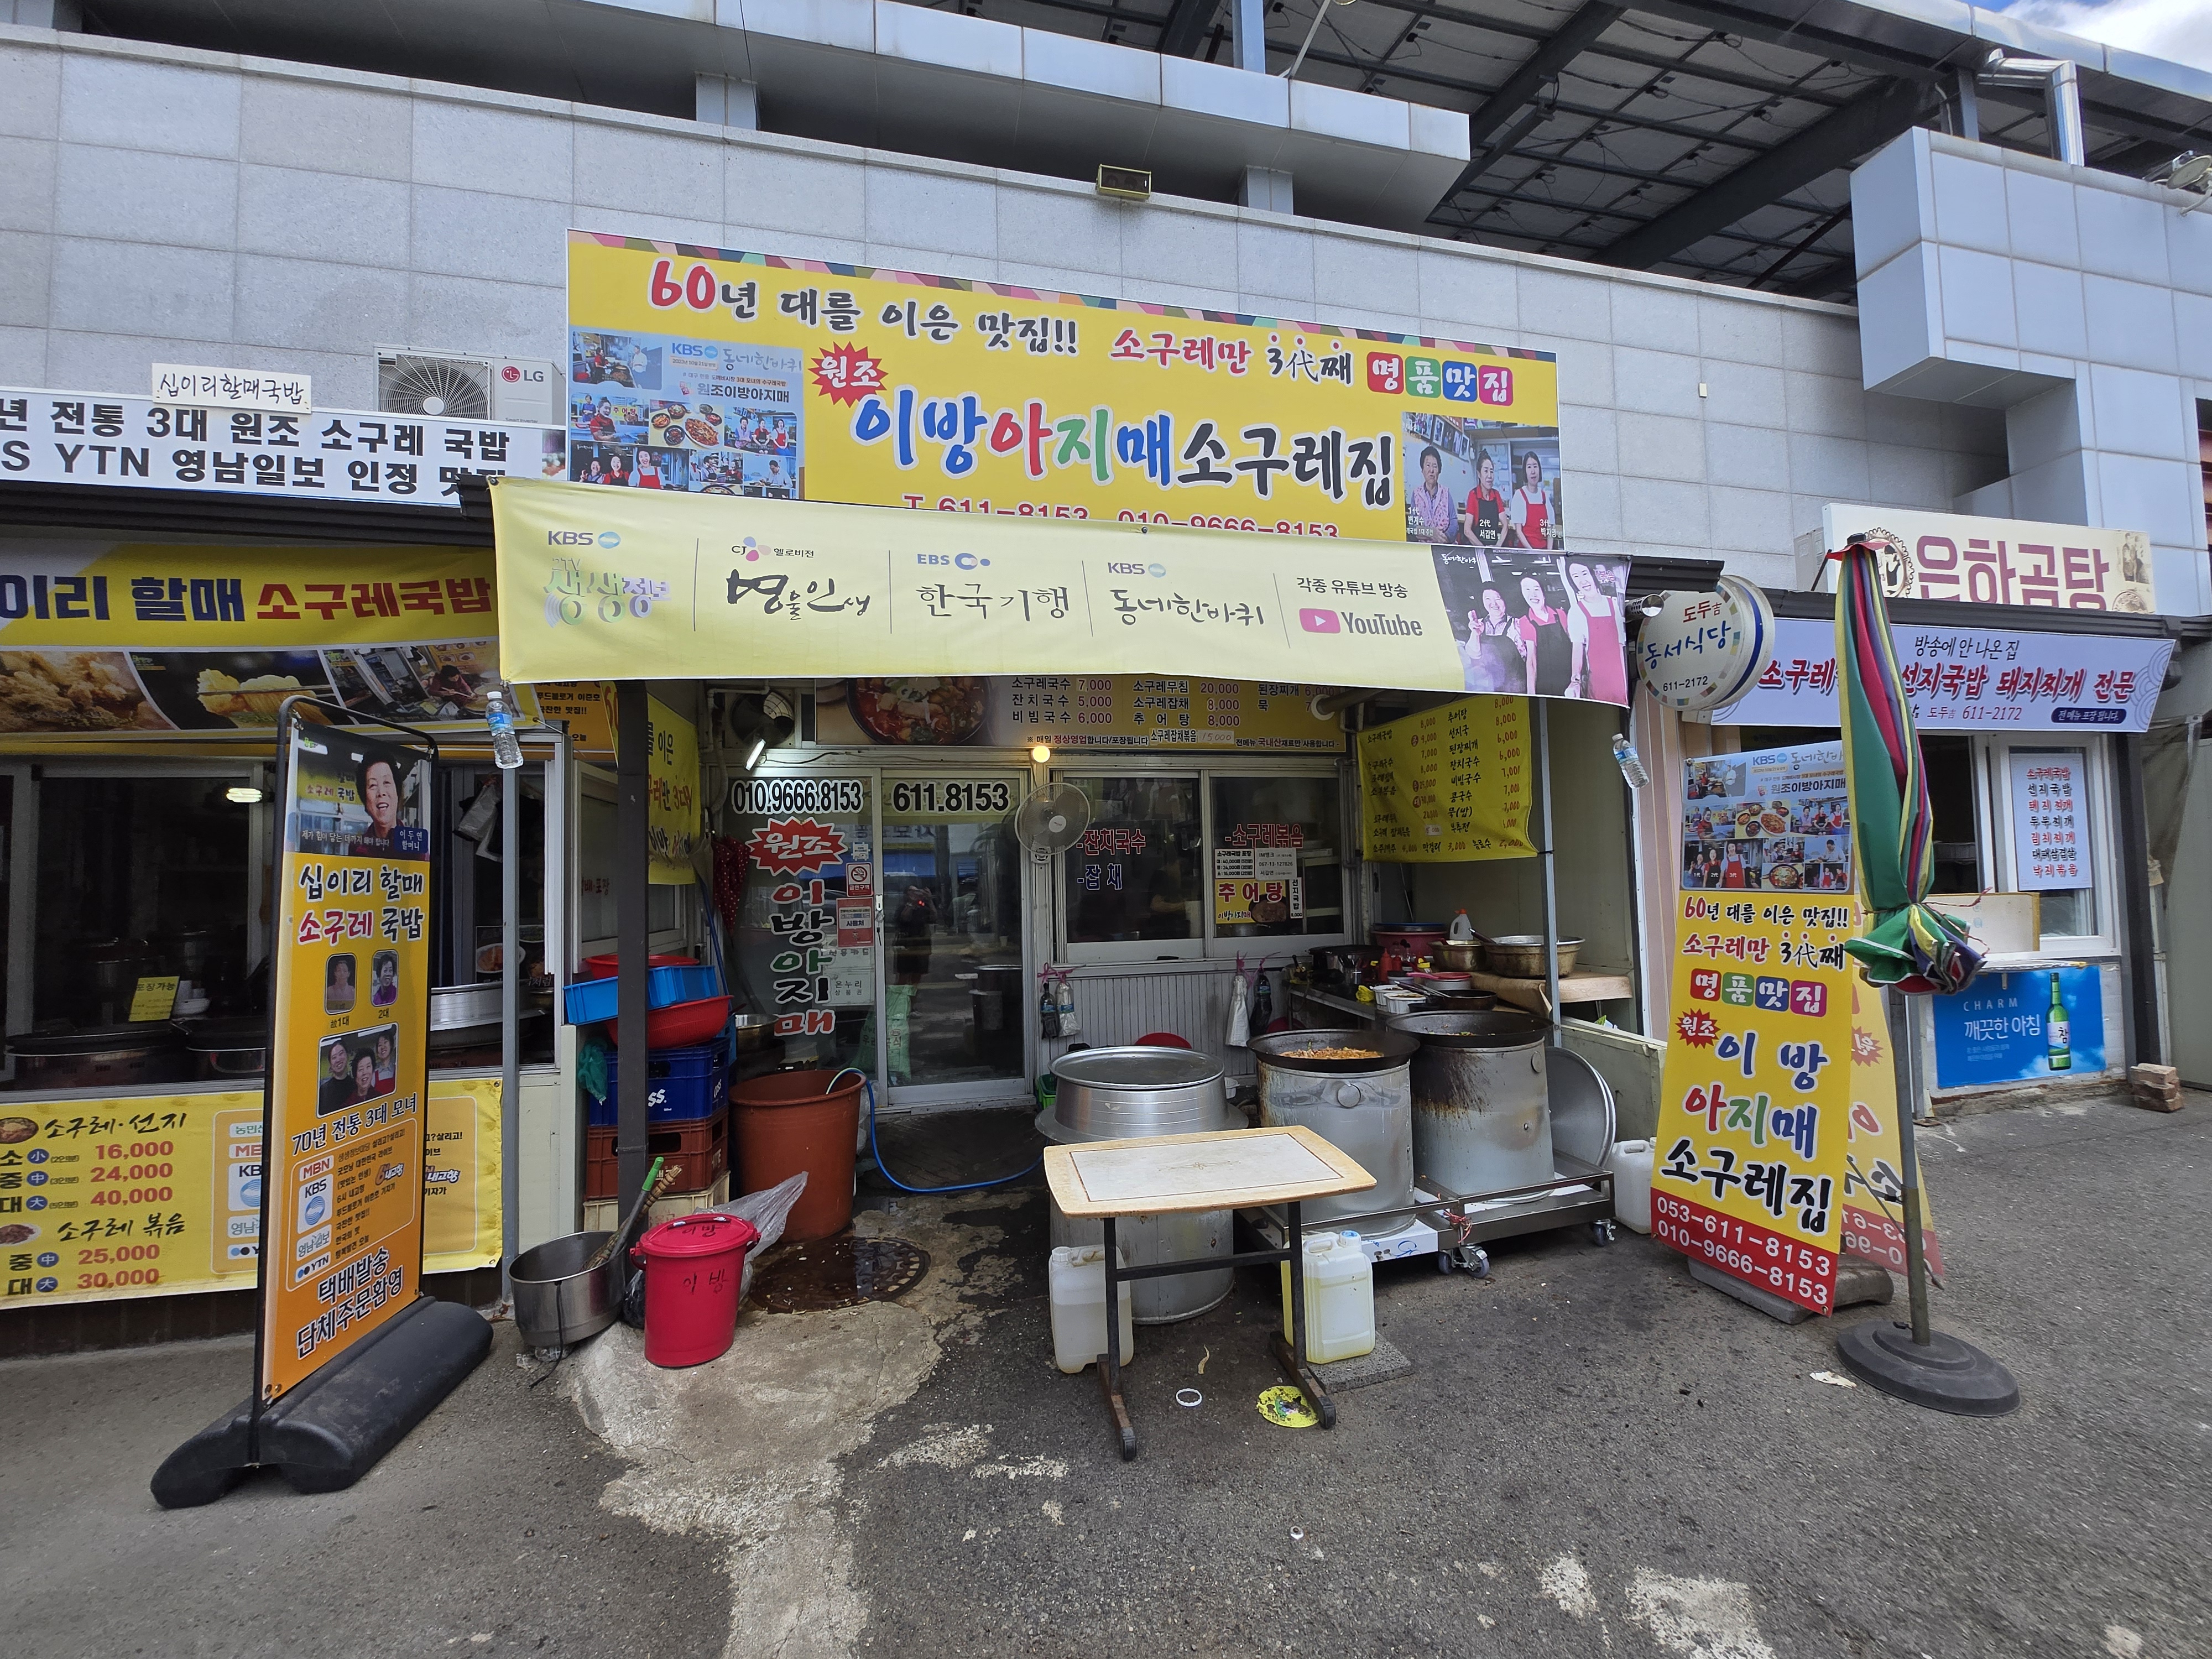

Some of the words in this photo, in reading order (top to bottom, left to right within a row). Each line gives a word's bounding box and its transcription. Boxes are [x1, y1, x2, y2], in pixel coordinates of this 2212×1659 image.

[650, 260, 757, 319] 60년
[780, 290, 863, 332] 대를
[882, 300, 960, 342] 이은
[978, 311, 1078, 354] 맛집!!
[1110, 328, 1252, 375] 소구레만
[1371, 359, 1510, 406] 명품맛집
[672, 343, 703, 356] KBS
[723, 348, 802, 372] 동네한바퀴
[524, 369, 544, 383] LG
[818, 356, 880, 391] 원조
[159, 372, 305, 405] 십이리할매국밥
[697, 383, 790, 403] 원조이방아지매
[50, 401, 125, 437] 전통
[147, 407, 207, 442] 3대
[231, 413, 300, 447] 원조
[321, 419, 424, 457] 소구레
[445, 427, 510, 463] 국밥
[54, 442, 149, 477] YTN
[172, 449, 325, 489] 영남일보
[348, 461, 417, 495] 인정
[548, 531, 593, 546] KBS
[731, 545, 747, 556] CJ
[774, 547, 814, 559] 헬로비전
[917, 554, 950, 566] EBS
[1108, 562, 1145, 576] KBS
[131, 577, 246, 622] 할매
[257, 577, 493, 620] 소구레국밥
[1297, 577, 1328, 595] 각종
[1331, 579, 1376, 597] 유튜브
[1378, 582, 1408, 599] 방송
[916, 583, 1070, 622] 한국기행
[1109, 588, 1264, 626] 동네한바퀴
[1340, 611, 1423, 637] YouTube
[1644, 619, 1731, 670] 동서식당
[1914, 634, 1957, 658] 방송에
[1959, 637, 1974, 658] 안
[1975, 639, 2003, 660] 나온
[2006, 640, 2020, 661] 집
[1012, 677, 1072, 690] 소구레국수
[1077, 680, 1113, 692] 7,000
[1133, 680, 1190, 694] 소구레무침
[1200, 682, 1239, 696] 20,000
[1258, 684, 1300, 697] 된장찌개
[1662, 675, 1709, 692] 611-2172
[1994, 665, 2086, 702] 돼지찌개
[2093, 669, 2136, 701] 전문
[1012, 694, 1071, 707] 잔치국수
[1078, 696, 1113, 709] 5,000
[1133, 696, 1190, 711] 소구레잡채
[1207, 698, 1240, 712] 8,000
[1962, 705, 2022, 721] 611-2172
[1012, 710, 1072, 725] 비빔국수
[1078, 713, 1113, 726] 6,000
[1208, 715, 1240, 728] 8,000
[1036, 735, 1051, 744] 매일
[1151, 728, 1197, 744] 소구레잡채볶음
[1752, 755, 1775, 766] KBS
[733, 780, 863, 813] 010.9666.8153
[892, 782, 1010, 812] 611.8153
[763, 833, 834, 860] 원조
[300, 866, 372, 901] 십이리
[380, 865, 423, 900] 할매
[1218, 882, 1283, 902] 추어탕
[299, 910, 373, 943] 소구레
[380, 907, 424, 941] 국밥
[1685, 896, 1720, 922] 60년
[1726, 903, 1756, 924] 대를
[1763, 905, 1795, 926] 이은
[1802, 907, 1848, 929] 맛집!!
[1682, 933, 1769, 961] 소구레만
[834, 980, 862, 989] 온누리
[1694, 972, 1822, 1014] 명품맛집
[1963, 997, 2018, 1011] CHARM
[1681, 1015, 1716, 1037] 원조
[1964, 1017, 2009, 1042] 깨끗한
[2011, 1013, 2041, 1036] 아침
[2058, 1027, 2069, 1045] 참
[292, 1123, 327, 1155] 70년
[332, 1113, 362, 1141] 전통
[365, 1103, 387, 1128] 3대
[391, 1092, 418, 1118] 모녀
[1684, 1084, 1818, 1159] 아지매
[0, 1149, 23, 1167] 소
[95, 1140, 174, 1160] 16,000
[0, 1171, 23, 1189] 중
[90, 1162, 173, 1183] 24,000
[303, 1158, 330, 1179] MBN
[0, 1196, 23, 1213] 대
[90, 1186, 173, 1207] 40,000
[304, 1178, 327, 1198] KBS
[1661, 1139, 1833, 1233] 소구레집
[58, 1218, 133, 1243] 소구레
[143, 1212, 186, 1239] 볶음
[1658, 1196, 1830, 1277] 053-611-8153
[8, 1253, 33, 1271] 중
[78, 1244, 160, 1266] 25,000
[310, 1254, 330, 1272] YTN
[1658, 1219, 1828, 1306] 010-9666-8153
[7, 1277, 33, 1296] 대
[77, 1268, 160, 1290] 30,000
[319, 1246, 389, 1304] 택배발송
[297, 1265, 404, 1361] 단체주문환영
